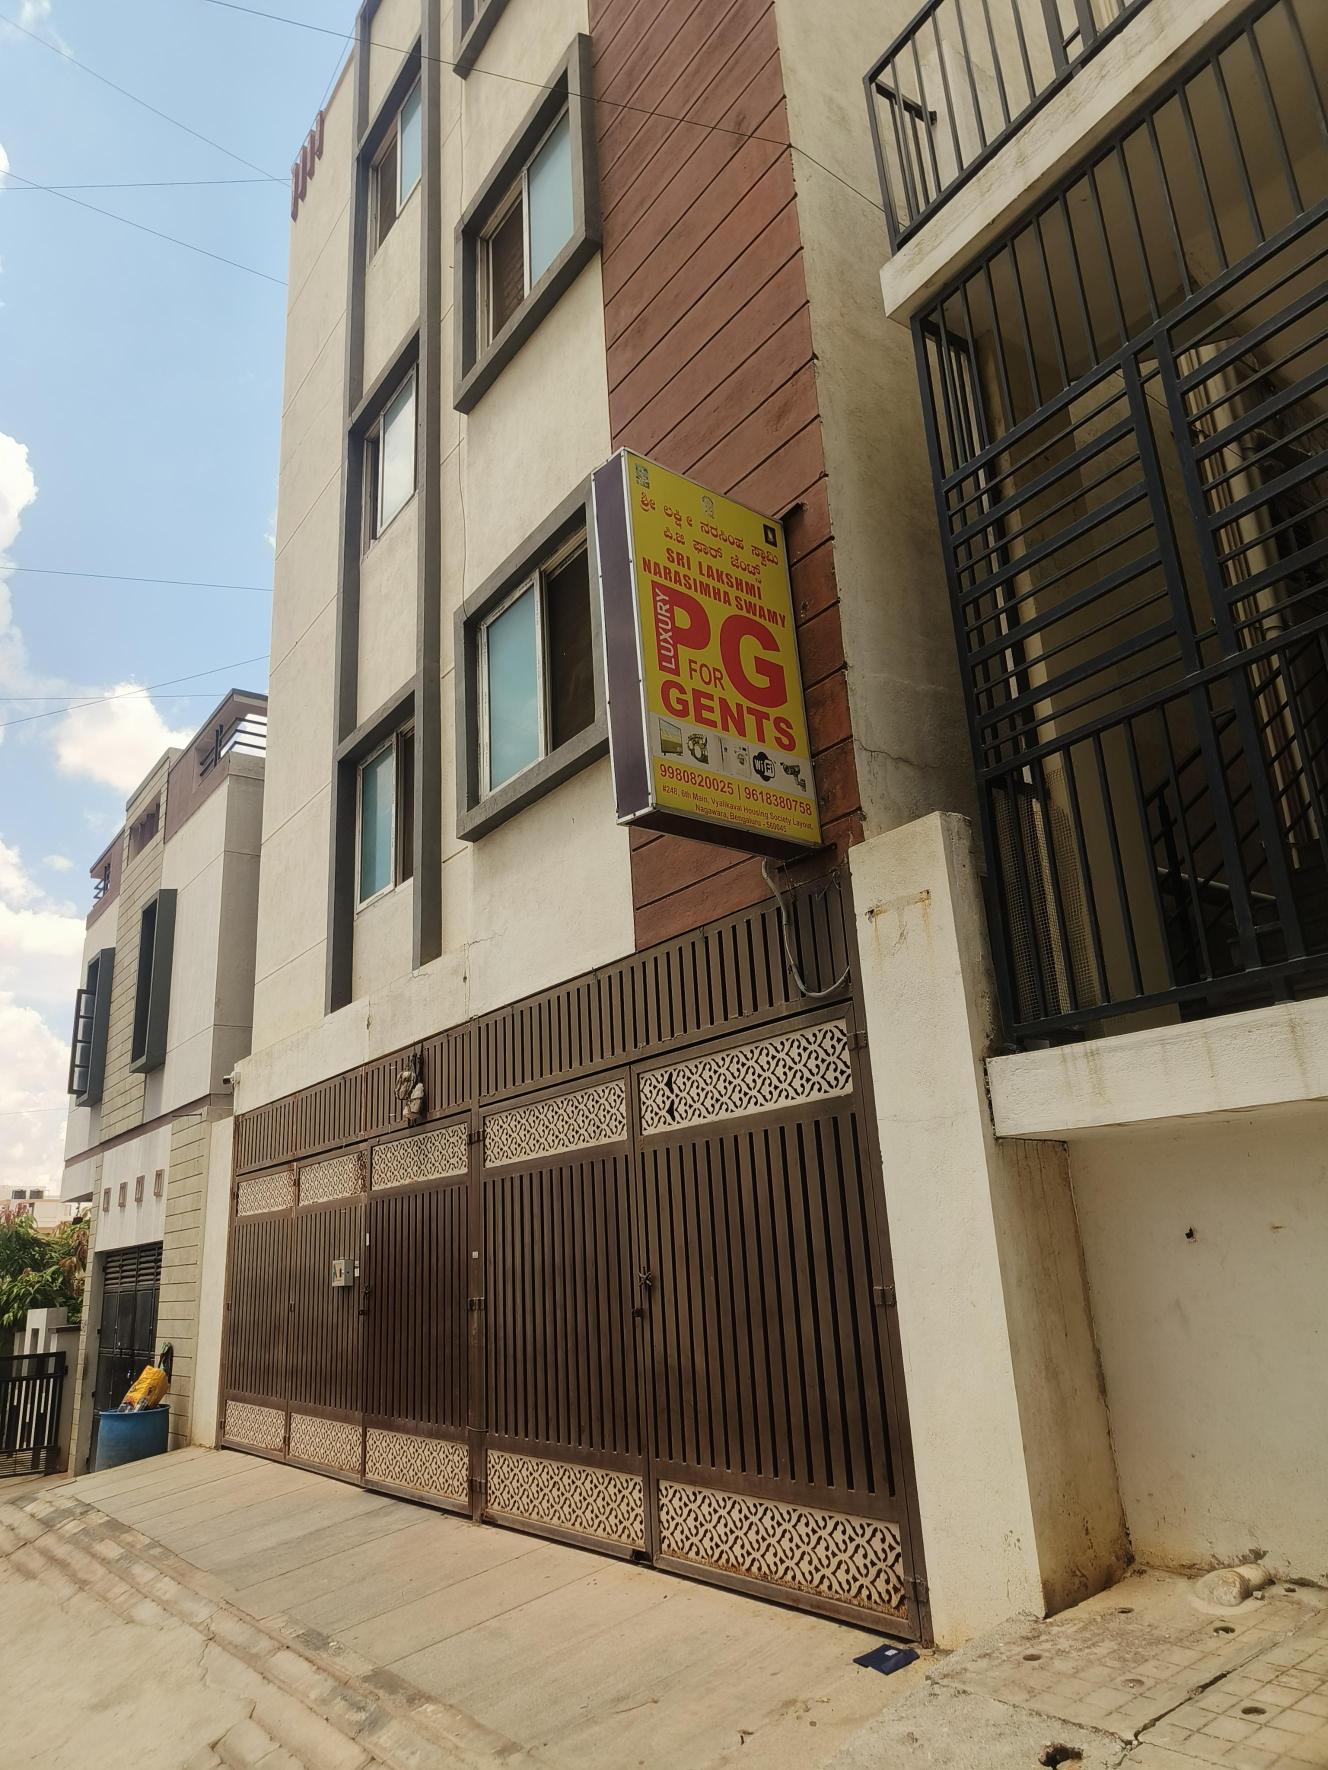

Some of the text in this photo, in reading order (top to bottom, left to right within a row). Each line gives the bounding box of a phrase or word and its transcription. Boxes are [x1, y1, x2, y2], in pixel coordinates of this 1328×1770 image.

[642, 557, 786, 628] NARASIMHA SWAMY
[666, 547, 762, 600] SRI LAKSHMI
[651, 581, 788, 709] PG
[656, 588, 676, 670] LUXURY
[688, 658, 725, 691] FOR
[660, 679, 797, 752] GENTS
[660, 764, 734, 795] 9980820025
[744, 787, 812, 816] 9618380758
